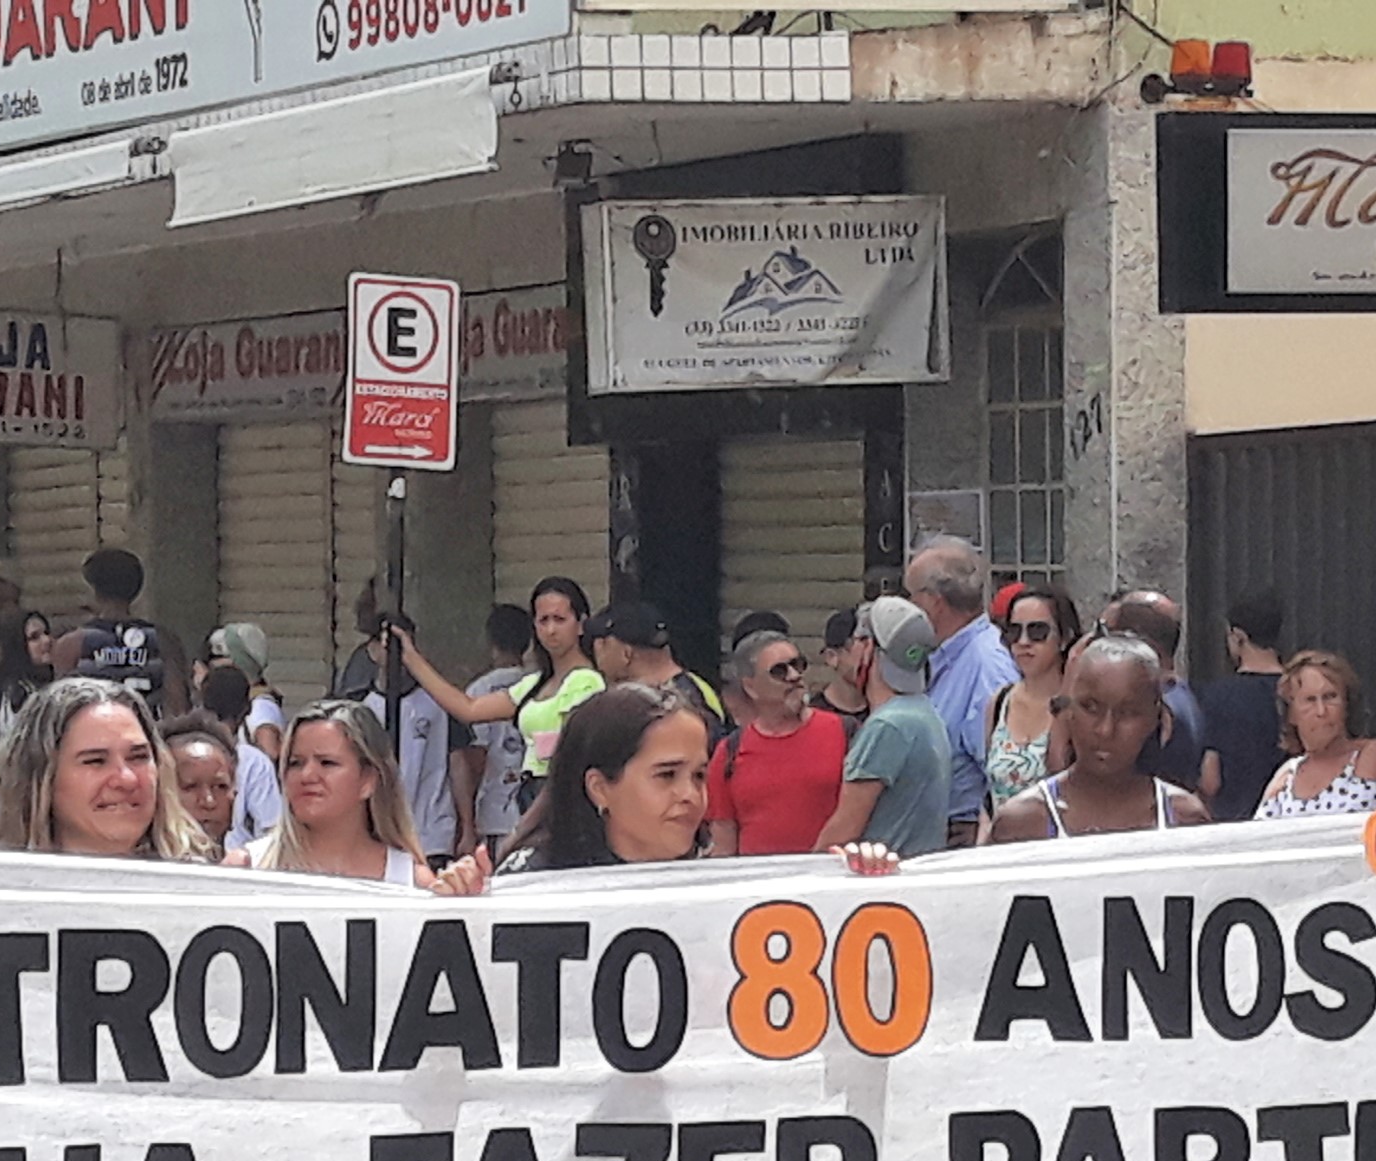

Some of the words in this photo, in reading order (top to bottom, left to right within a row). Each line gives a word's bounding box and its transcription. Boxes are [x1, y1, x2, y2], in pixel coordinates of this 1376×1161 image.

[155, 52, 189, 92] 1972
[681, 218, 823, 243] IMOBILIÁRIA
[828, 221, 919, 240] RIBEIRO
[236, 325, 344, 380] Guaran
[387, 307, 417, 357] E
[727, 900, 933, 1060] 80
